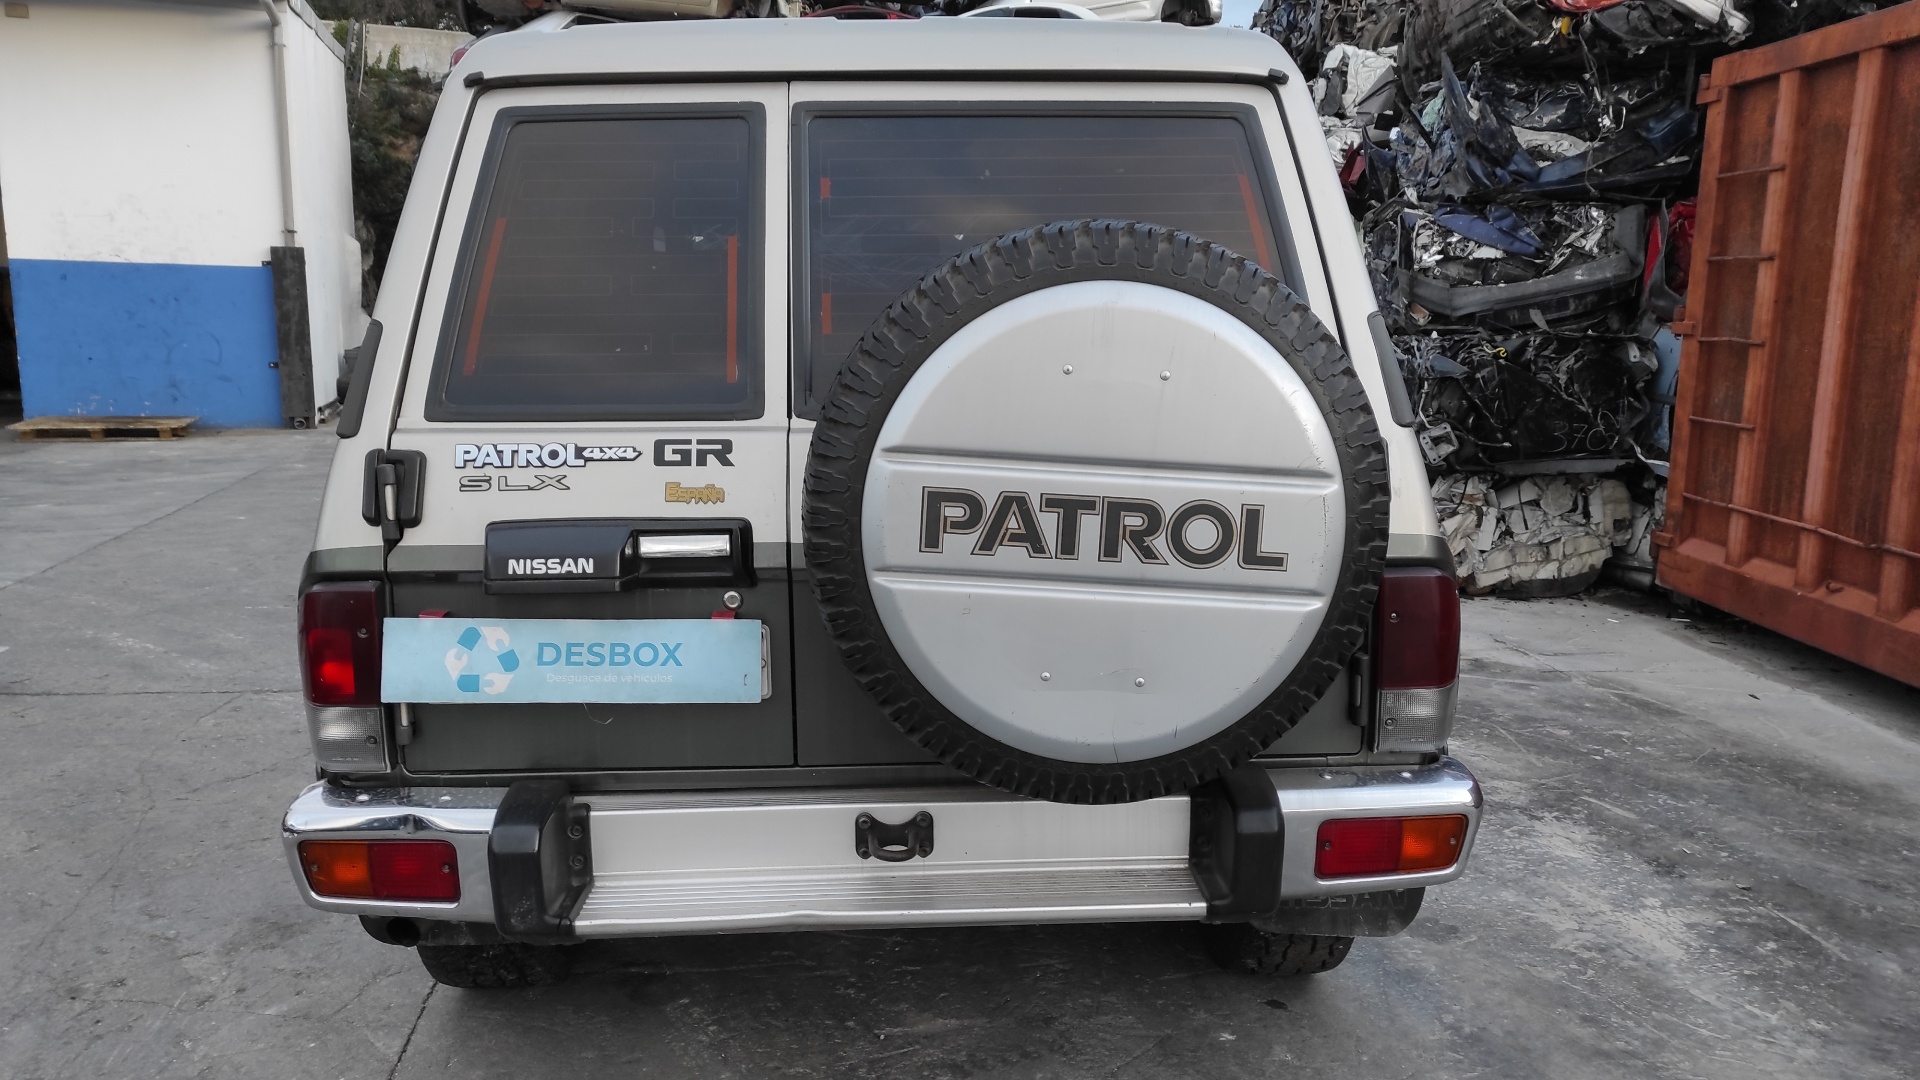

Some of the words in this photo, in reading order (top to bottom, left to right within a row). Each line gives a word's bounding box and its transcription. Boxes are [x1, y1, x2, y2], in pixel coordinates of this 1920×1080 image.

[455, 442, 586, 468] PATROL
[654, 438, 735, 467] GR
[459, 475, 570, 491] SLX
[919, 486, 1289, 571] PATROL
[508, 558, 594, 574] NISSAN
[537, 642, 683, 667] DESBOX
[546, 673, 601, 685] Desguace
[604, 673, 618, 683] de
[1279, 889, 1407, 909] SSAN
